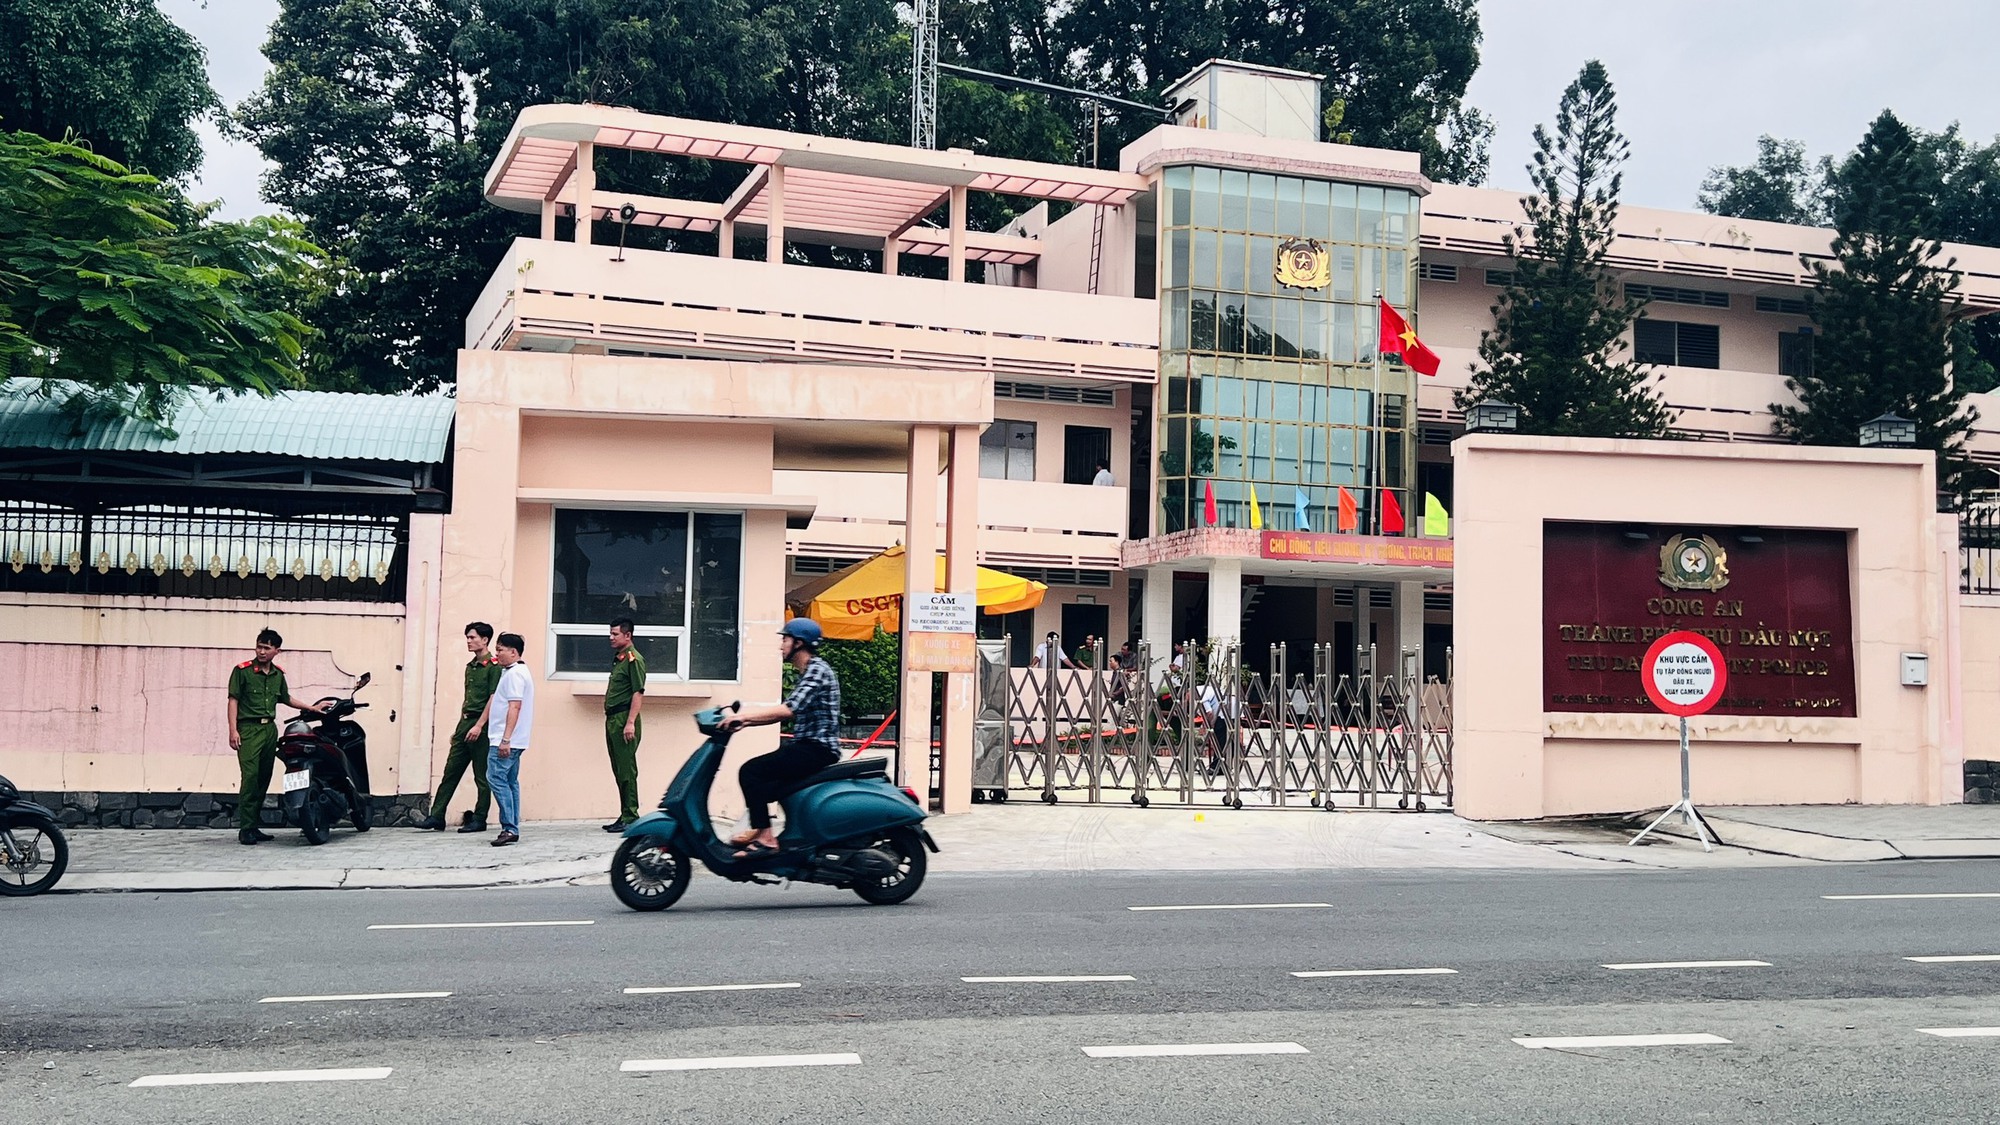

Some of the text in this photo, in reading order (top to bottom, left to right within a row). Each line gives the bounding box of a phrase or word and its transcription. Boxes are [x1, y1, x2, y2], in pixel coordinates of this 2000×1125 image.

[1269, 534, 1286, 553] CHỦ
[846, 593, 901, 615] CSGT
[931, 595, 956, 604] CẤM
[1713, 600, 1744, 617] AN
[1559, 622, 1637, 643] THÀNH
[1659, 655, 1674, 663] KHU
[1760, 658, 1829, 676] POLICE
